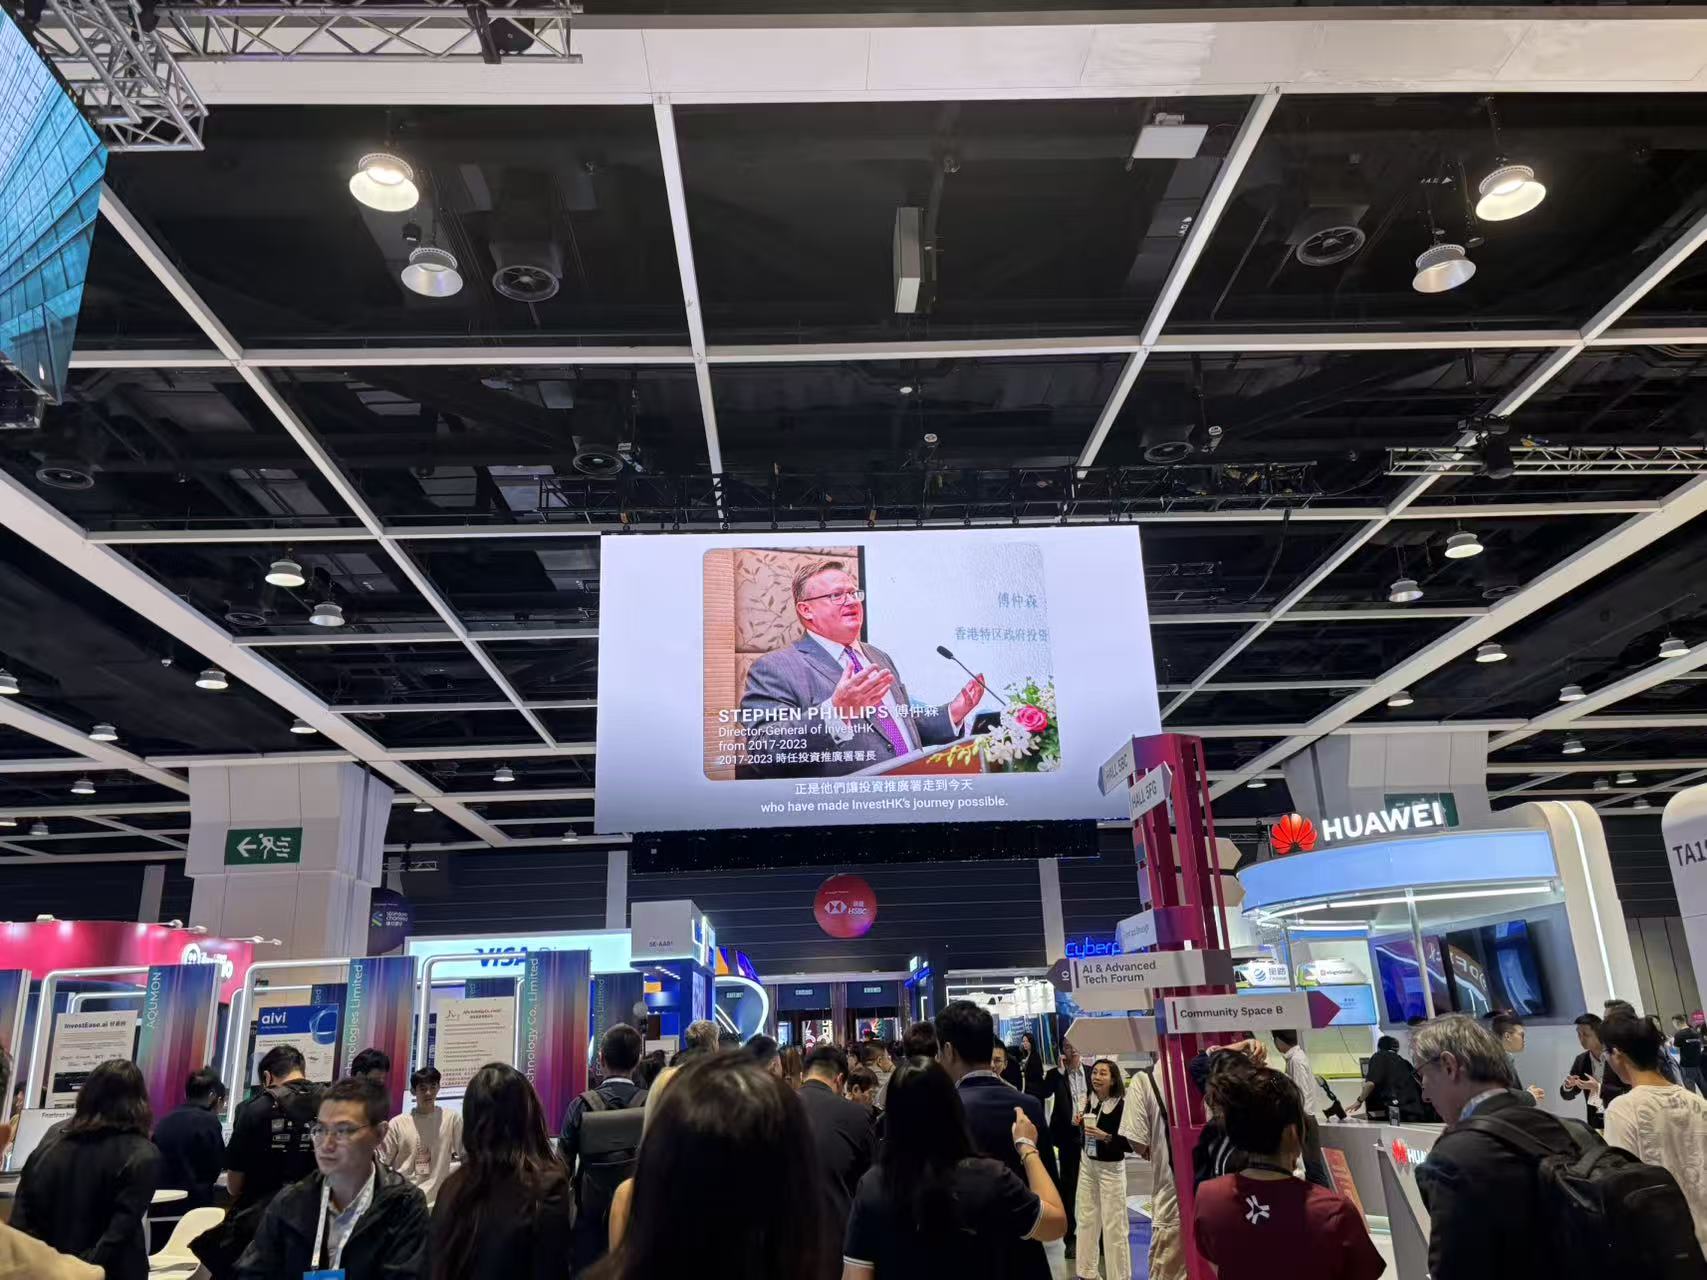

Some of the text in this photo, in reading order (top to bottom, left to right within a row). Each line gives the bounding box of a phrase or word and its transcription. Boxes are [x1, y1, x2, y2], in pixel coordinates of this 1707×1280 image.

[718, 707, 801, 723] STEPHEN
[808, 705, 889, 721] PHILLIPS
[718, 723, 875, 738] Director-General of InvestHK
[719, 739, 807, 752] from 2017-2023
[719, 751, 877, 765] 2017-2023 時任投資推廣署署長
[795, 779, 974, 795] 正是他們讓投資推廣署走到今天
[760, 796, 1009, 813] who have made InvestHK's journey possible.
[1132, 789, 1146, 809] HALL
[1321, 801, 1444, 842] HUAWEI
[1672, 839, 1707, 867] TA1
[475, 946, 528, 968] VISA
[1082, 960, 1156, 974] AI & Advanced
[527, 958, 539, 1001] Limited
[1083, 972, 1145, 985] Tech Forum
[146, 971, 162, 1029] AQUMON
[261, 1011, 287, 1024] aivi
[344, 964, 364, 1077] chnologies Limited
[1180, 1004, 1284, 1020] Community Space B
[524, 1026, 538, 1086] chnology
